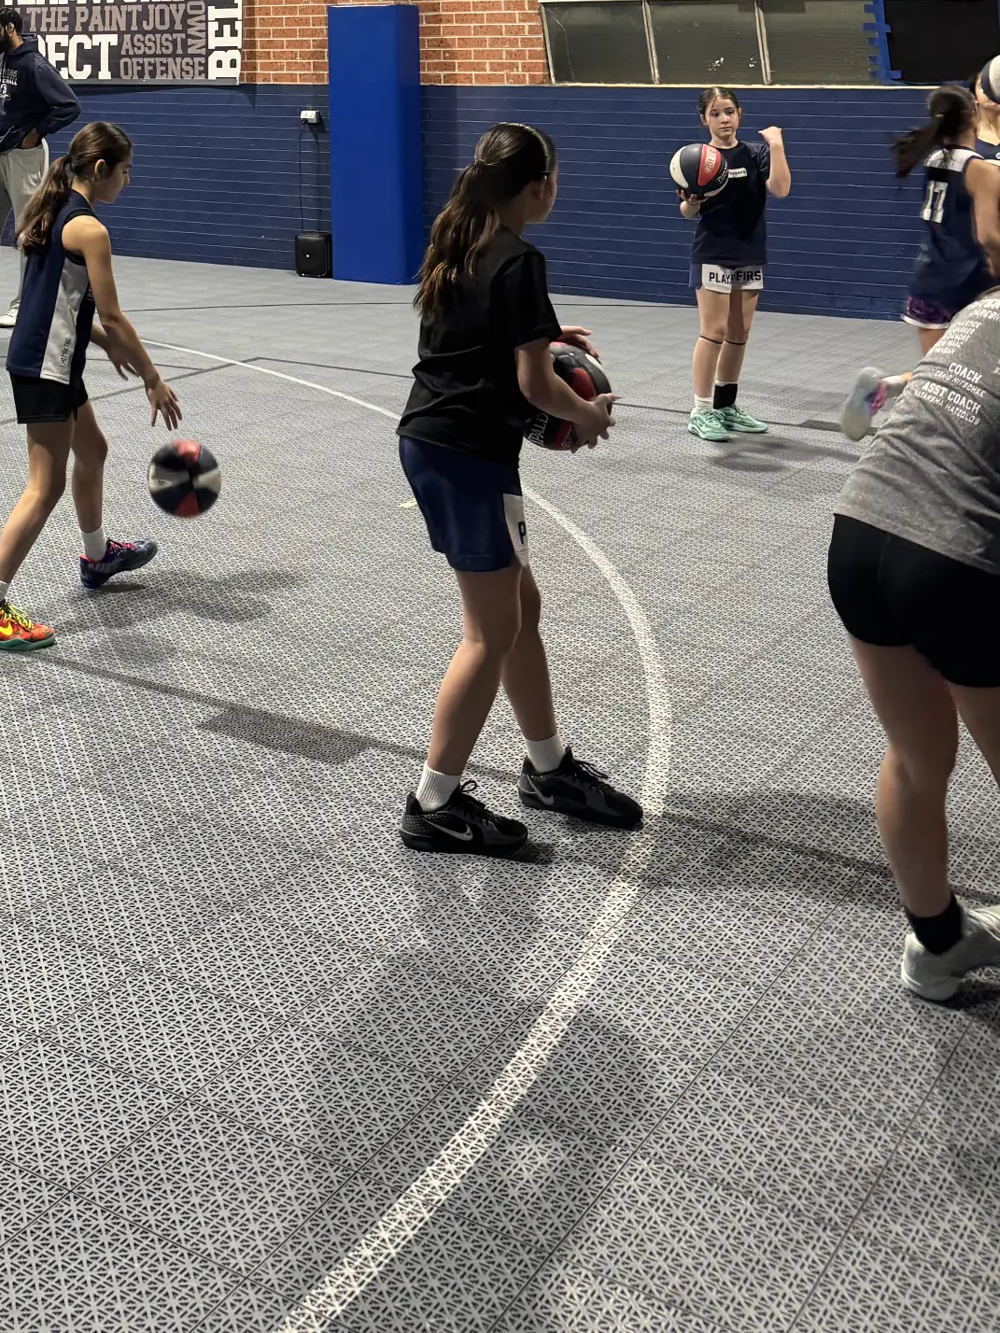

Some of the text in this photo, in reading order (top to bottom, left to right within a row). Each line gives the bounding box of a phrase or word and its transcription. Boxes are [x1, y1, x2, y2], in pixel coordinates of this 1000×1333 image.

[27, 6, 69, 32] THE
[75, 5, 142, 32] PAINT
[143, 4, 185, 31] JOY
[121, 34, 186, 55] ASSIST
[119, 57, 206, 80] OFFENSE
[948, 362, 983, 384] COACH
[921, 380, 982, 414] ASST COACH
